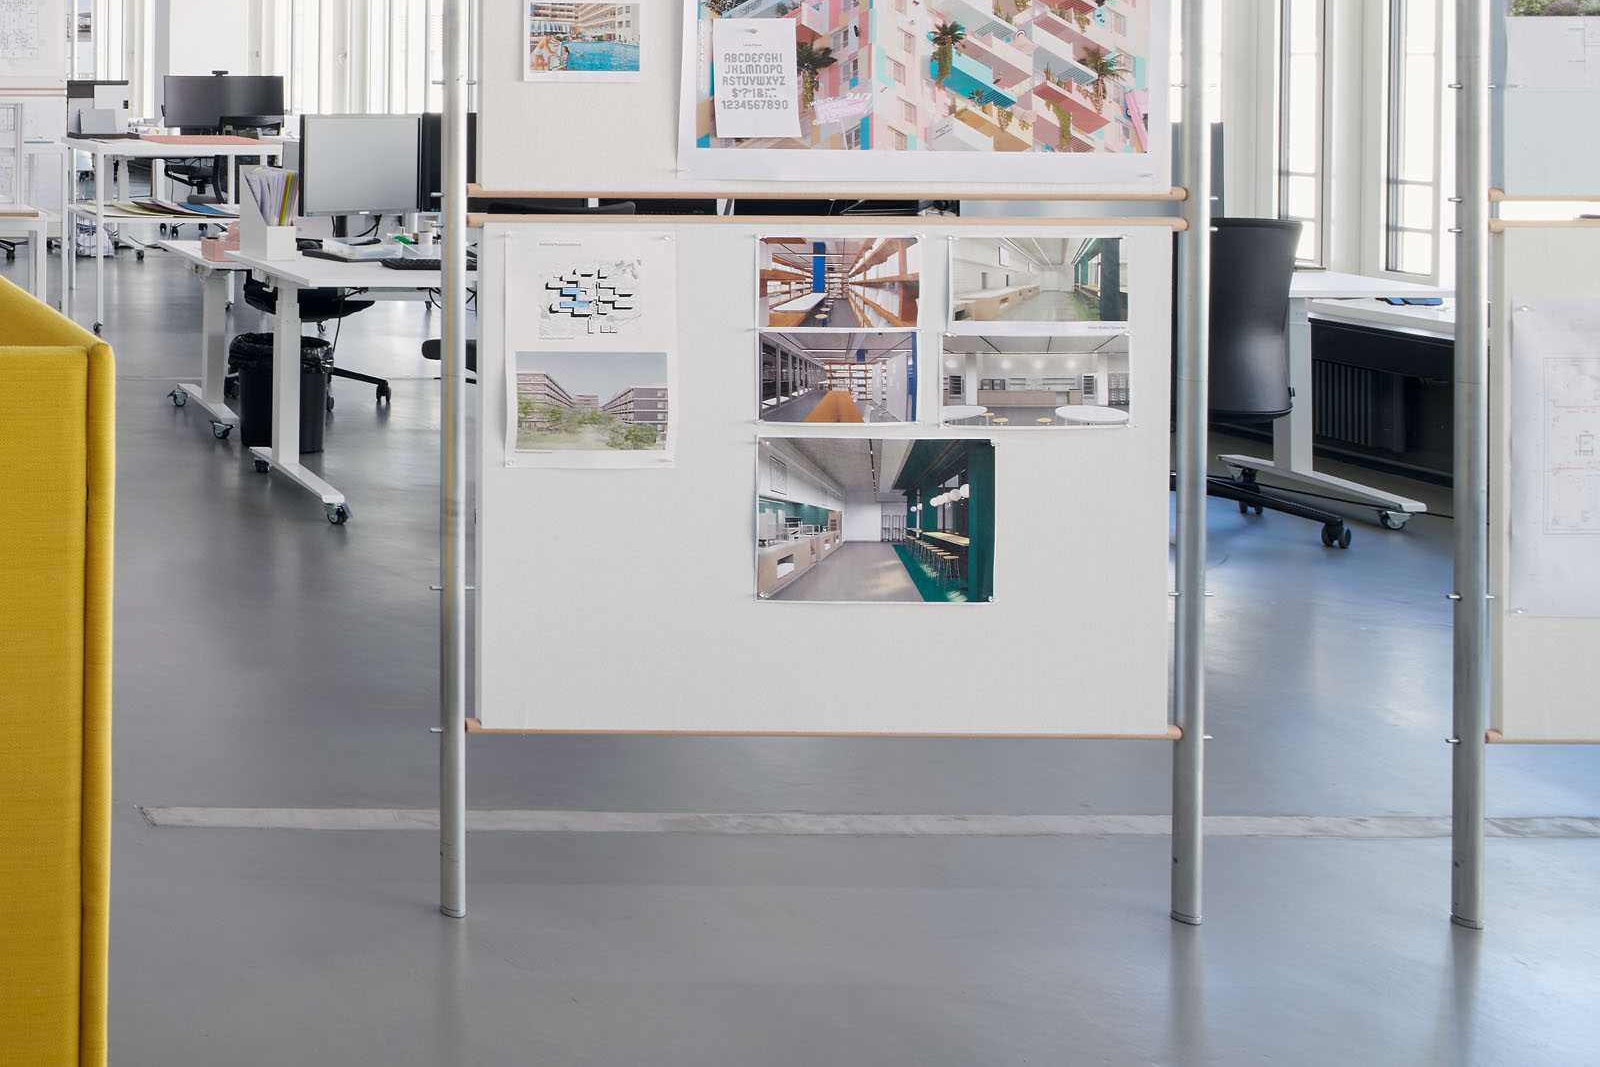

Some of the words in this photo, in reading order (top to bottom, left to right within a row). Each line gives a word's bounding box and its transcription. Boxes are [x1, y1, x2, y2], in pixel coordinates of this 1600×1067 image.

[724, 53, 783, 63] ABCDEFGHI
[724, 64, 783, 74] JKLMNOPQ
[722, 76, 786, 86] RSTUVWXYZ
[721, 99, 788, 110] 1234567890
